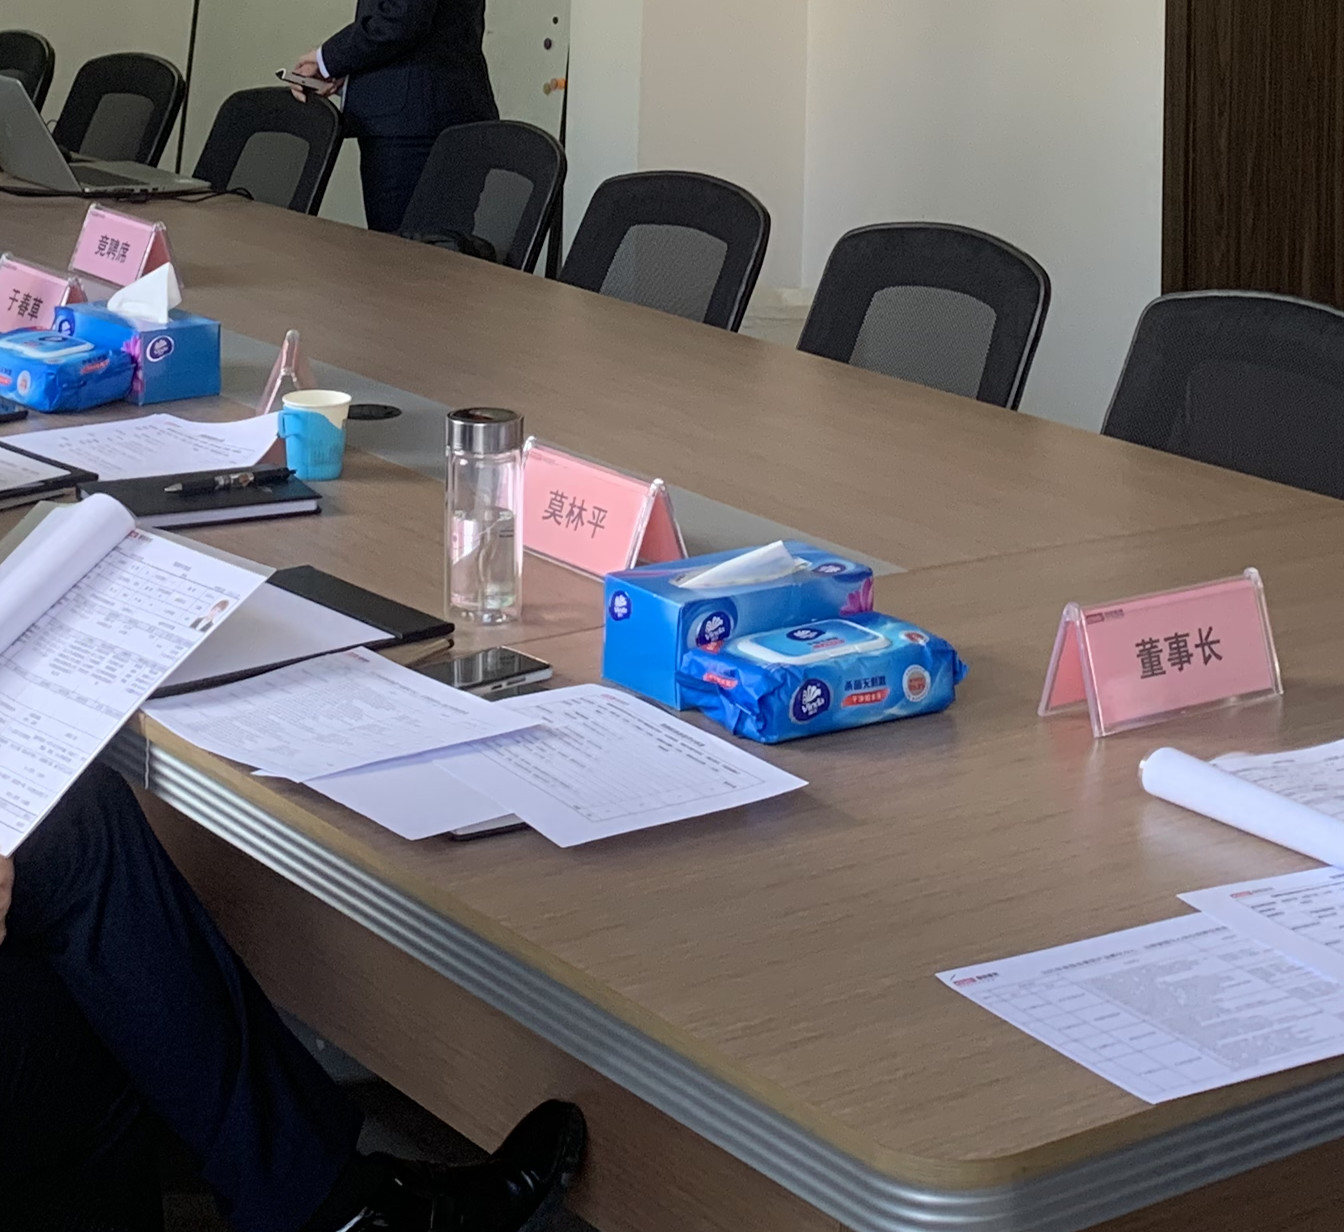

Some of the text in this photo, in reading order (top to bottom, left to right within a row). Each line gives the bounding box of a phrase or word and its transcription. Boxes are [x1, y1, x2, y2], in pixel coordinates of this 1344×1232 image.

[95, 234, 131, 264] 竞聘席
[541, 489, 608, 539] 莫林平
[1134, 626, 1223, 679] 董事长
[801, 697, 825, 714] Vinda
